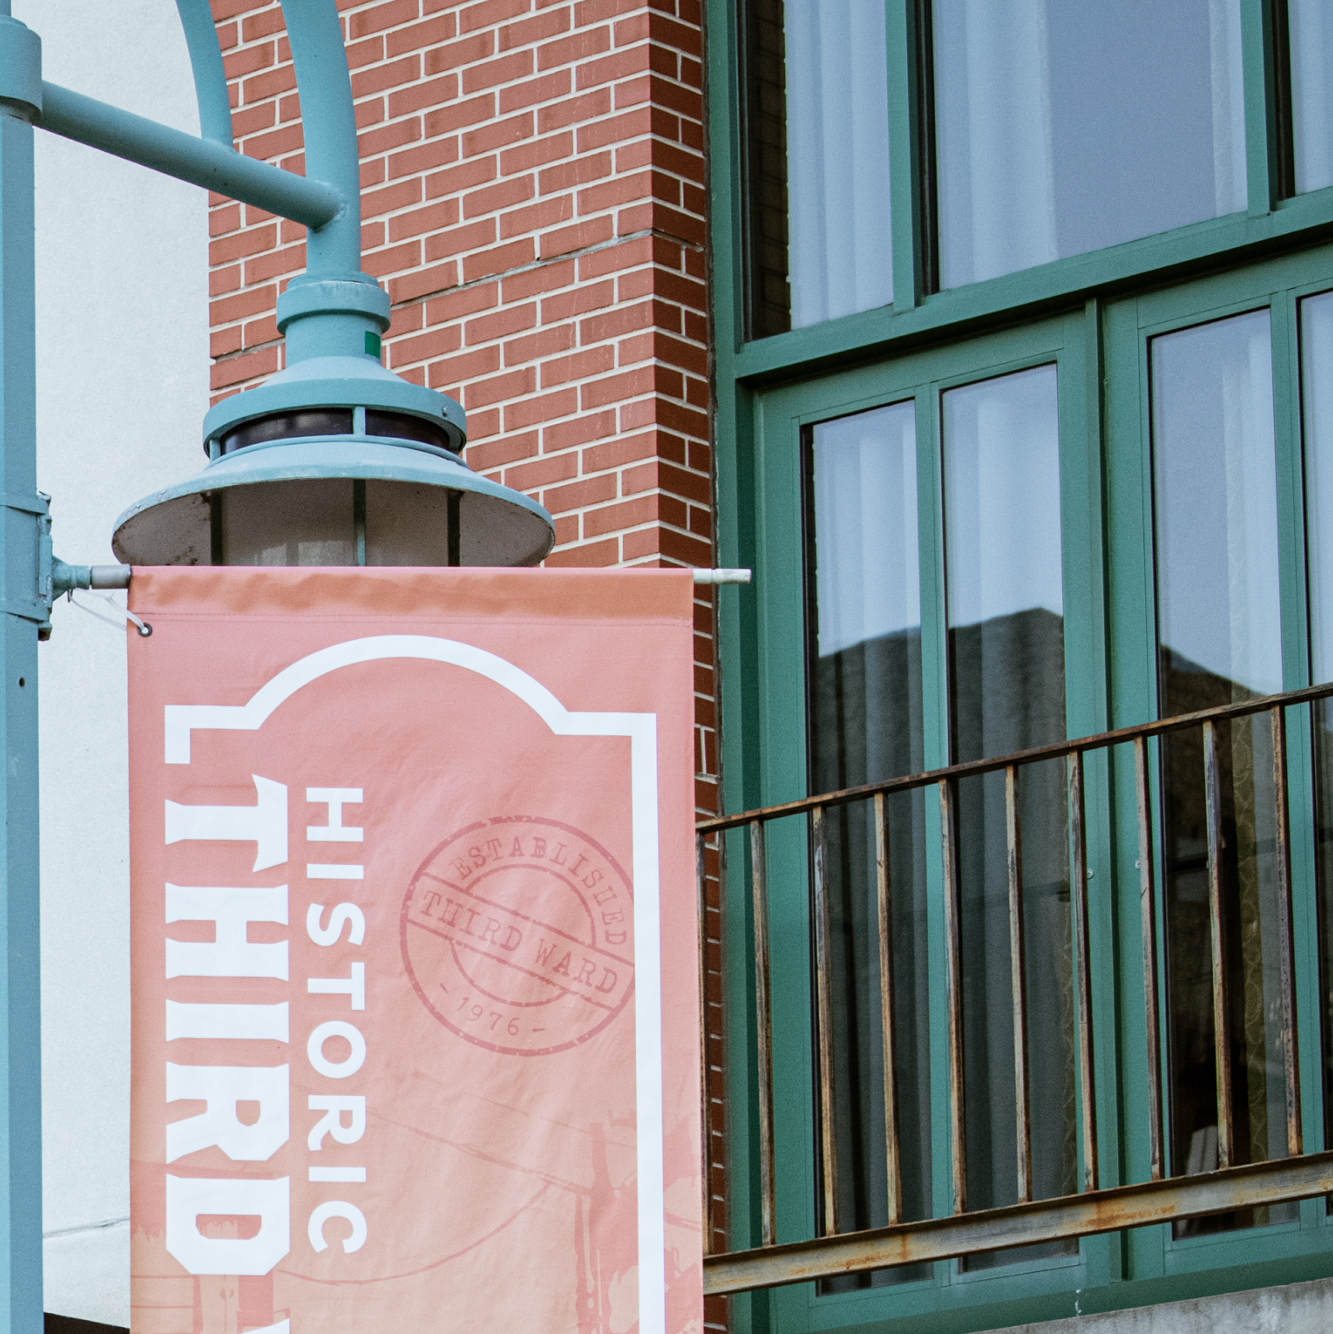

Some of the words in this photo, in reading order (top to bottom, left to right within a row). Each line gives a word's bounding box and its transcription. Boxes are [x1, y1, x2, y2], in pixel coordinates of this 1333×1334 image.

[420, 890, 523, 952] THIRD
[534, 938, 618, 994] WARD
[449, 836, 627, 945] ESTABLISHED
[164, 774, 290, 1276] THIRD
[306, 787, 368, 1254] HISTORIC
[456, 997, 520, 1036] 1976
